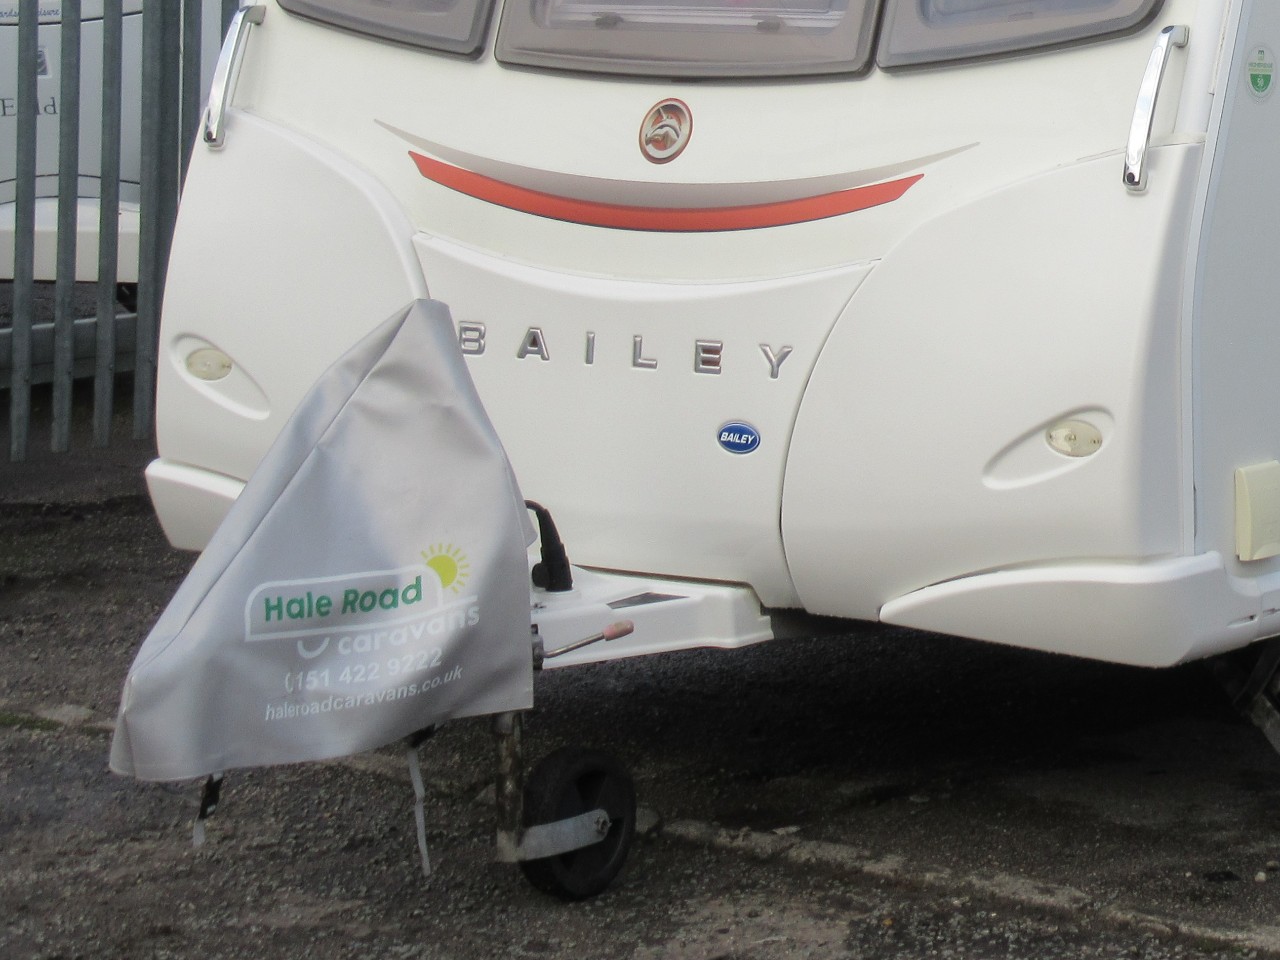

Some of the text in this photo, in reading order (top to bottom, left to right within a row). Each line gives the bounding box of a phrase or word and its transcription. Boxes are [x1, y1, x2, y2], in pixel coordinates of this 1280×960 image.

[457, 321, 793, 380] BAILEY
[720, 432, 755, 445] BAILEY
[264, 575, 423, 622] Hale Road
[337, 604, 480, 656] caravans
[338, 661, 381, 685] 422
[386, 647, 443, 677] 9222
[264, 664, 463, 721] haleroadcaravans.co.uk
